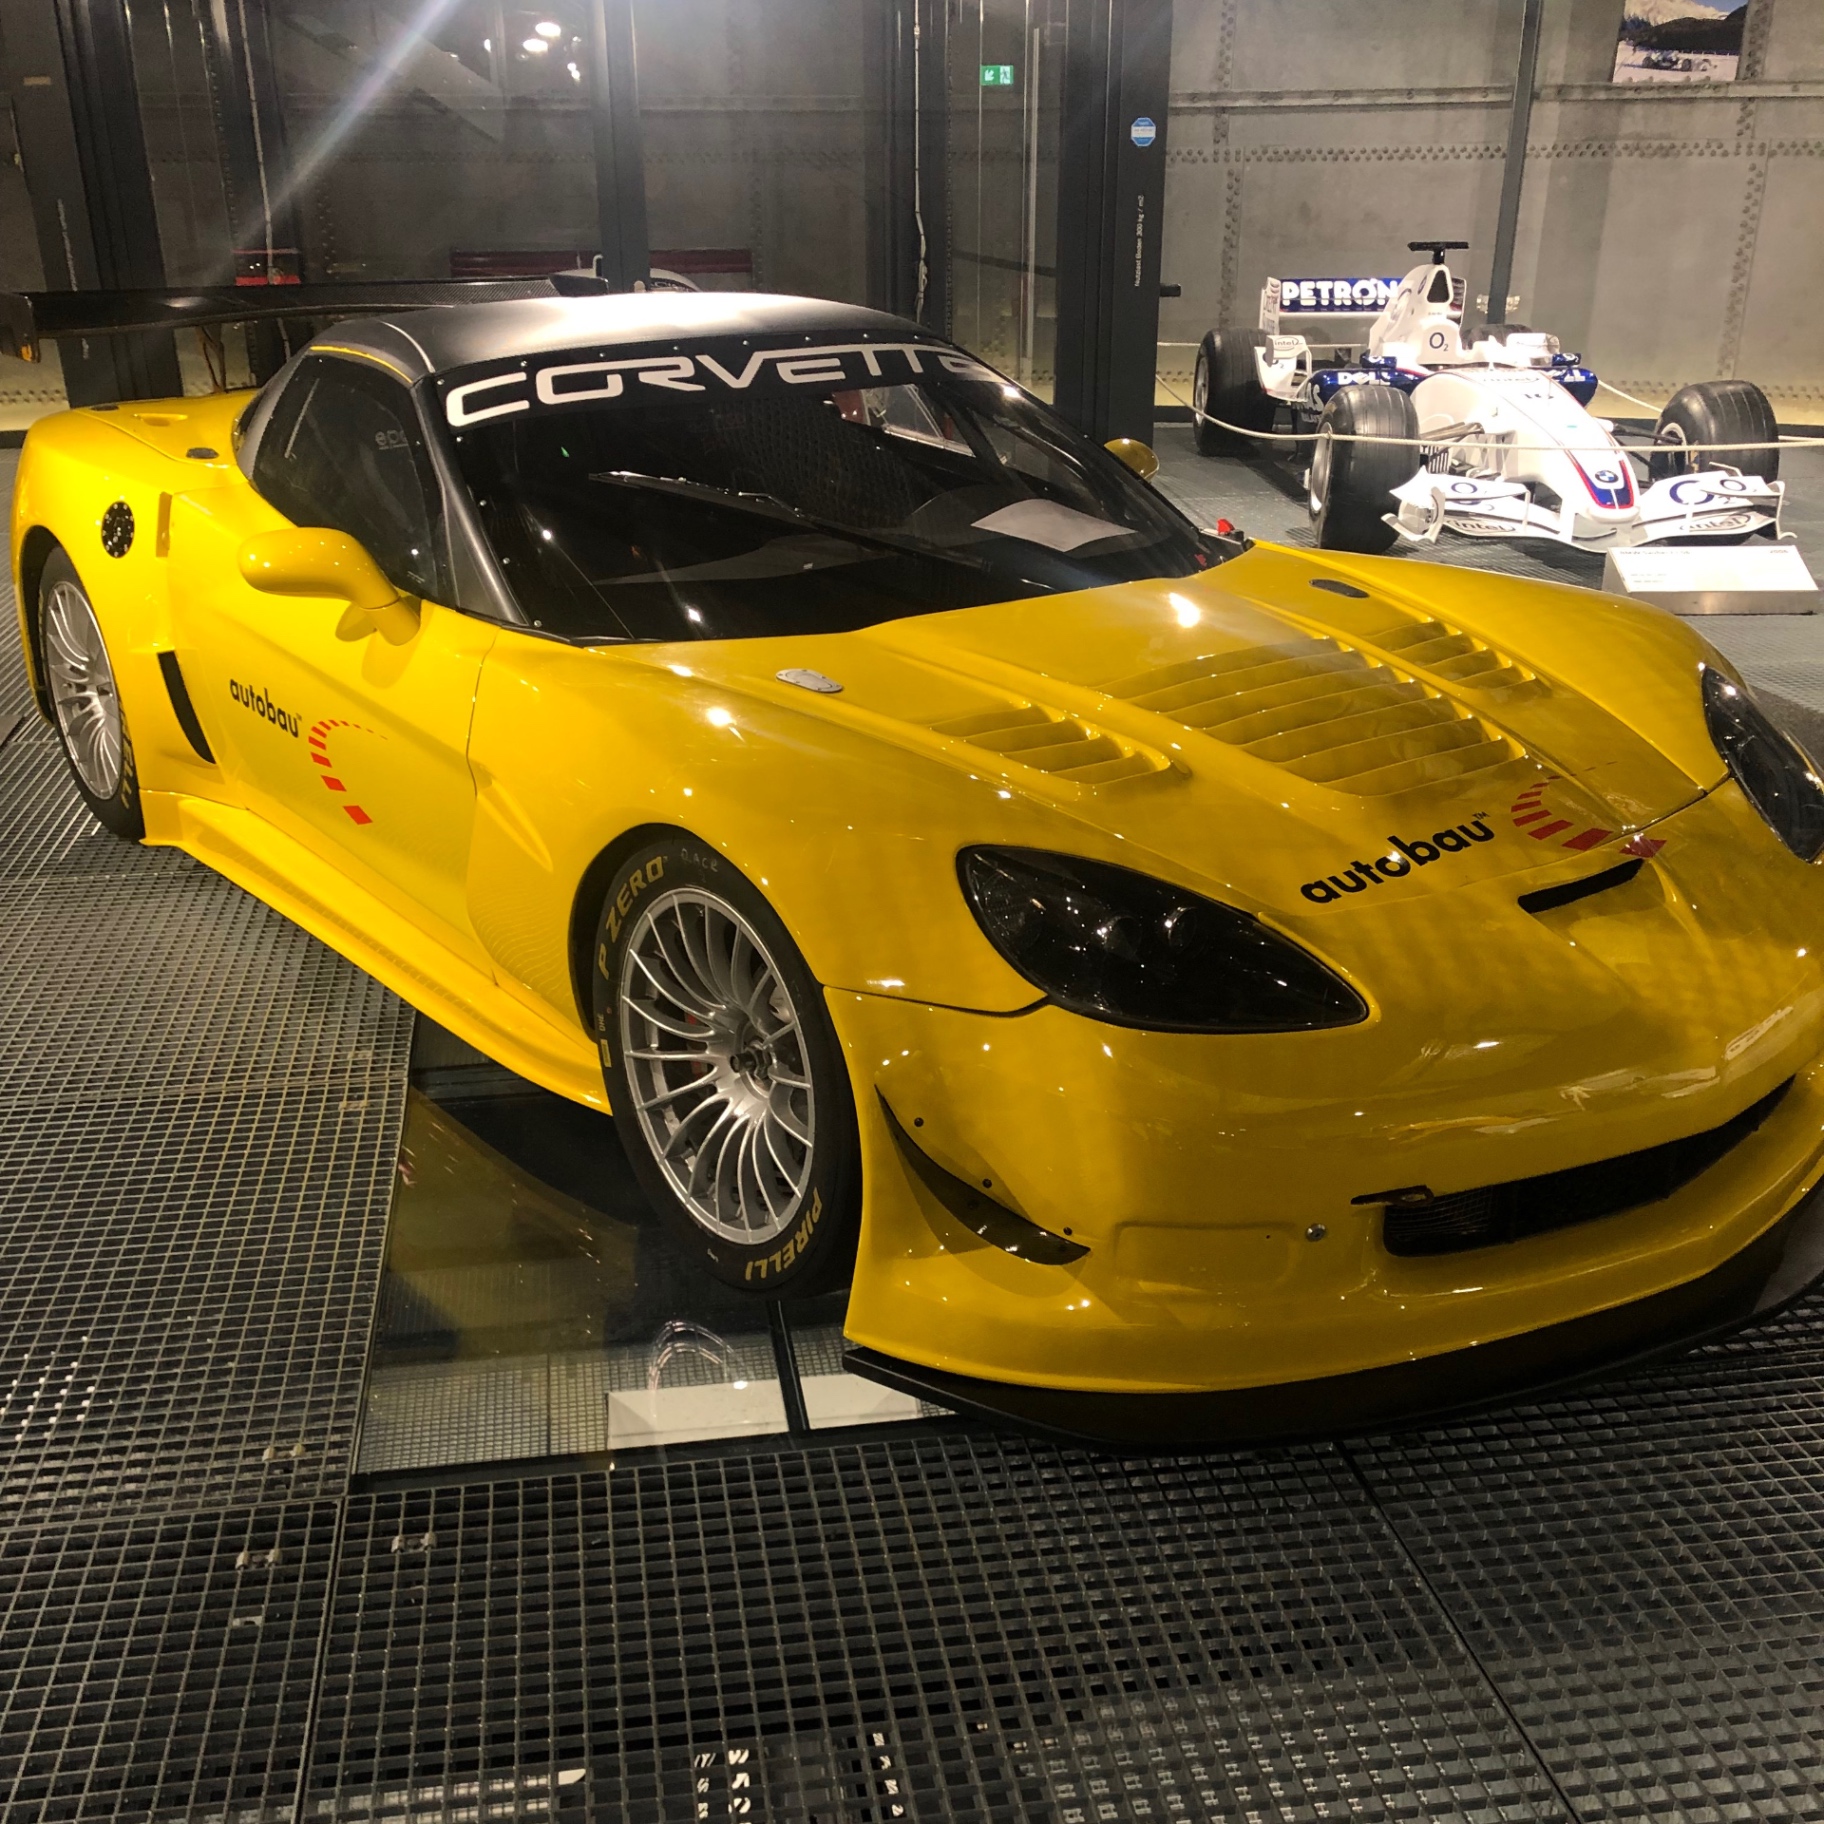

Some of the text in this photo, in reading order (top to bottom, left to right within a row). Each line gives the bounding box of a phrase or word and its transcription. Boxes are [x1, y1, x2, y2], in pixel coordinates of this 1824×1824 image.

[446, 343, 1003, 428] CORVETTE
[598, 856, 665, 980] P ZERO
[745, 1186, 823, 1281] PIRELLI
